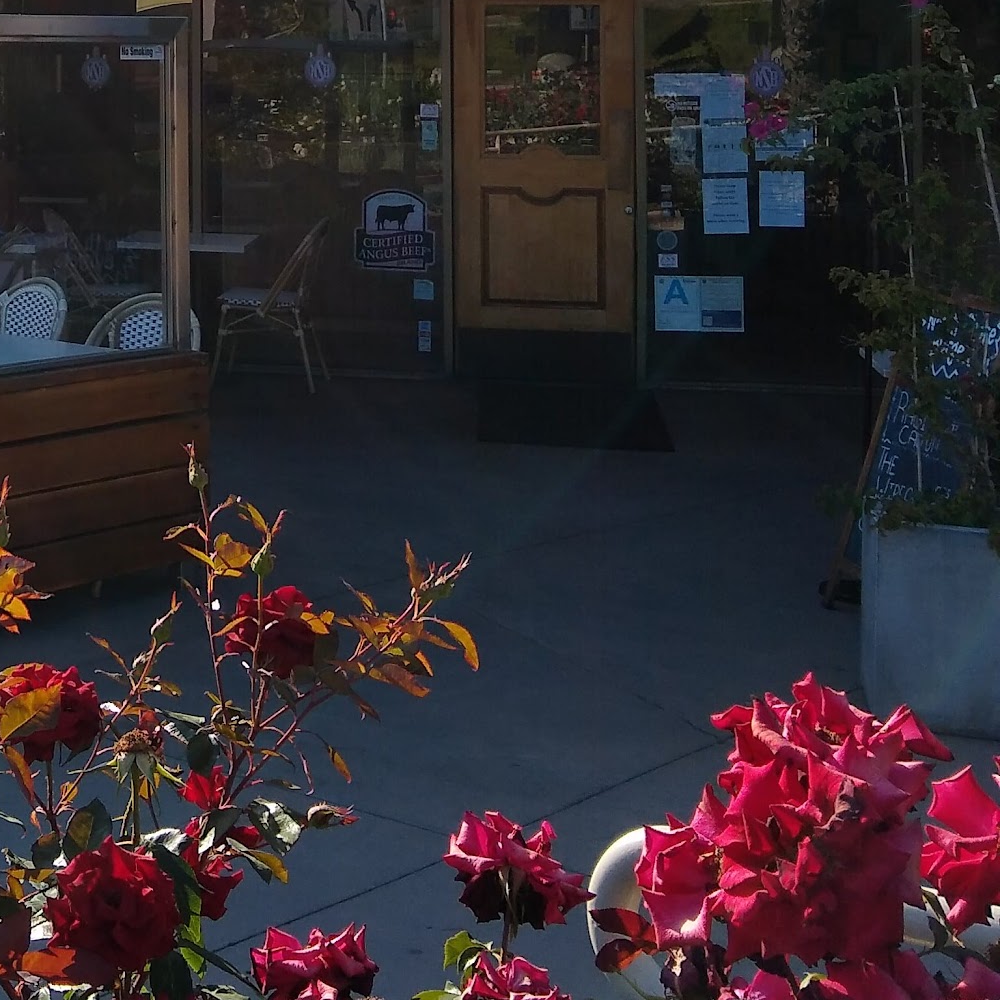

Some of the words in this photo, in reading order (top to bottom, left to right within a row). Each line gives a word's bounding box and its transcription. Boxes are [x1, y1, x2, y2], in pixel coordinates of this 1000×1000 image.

[363, 234, 424, 248] CERTIFIED
[359, 247, 399, 259] ANGUS
[663, 279, 689, 305] A
